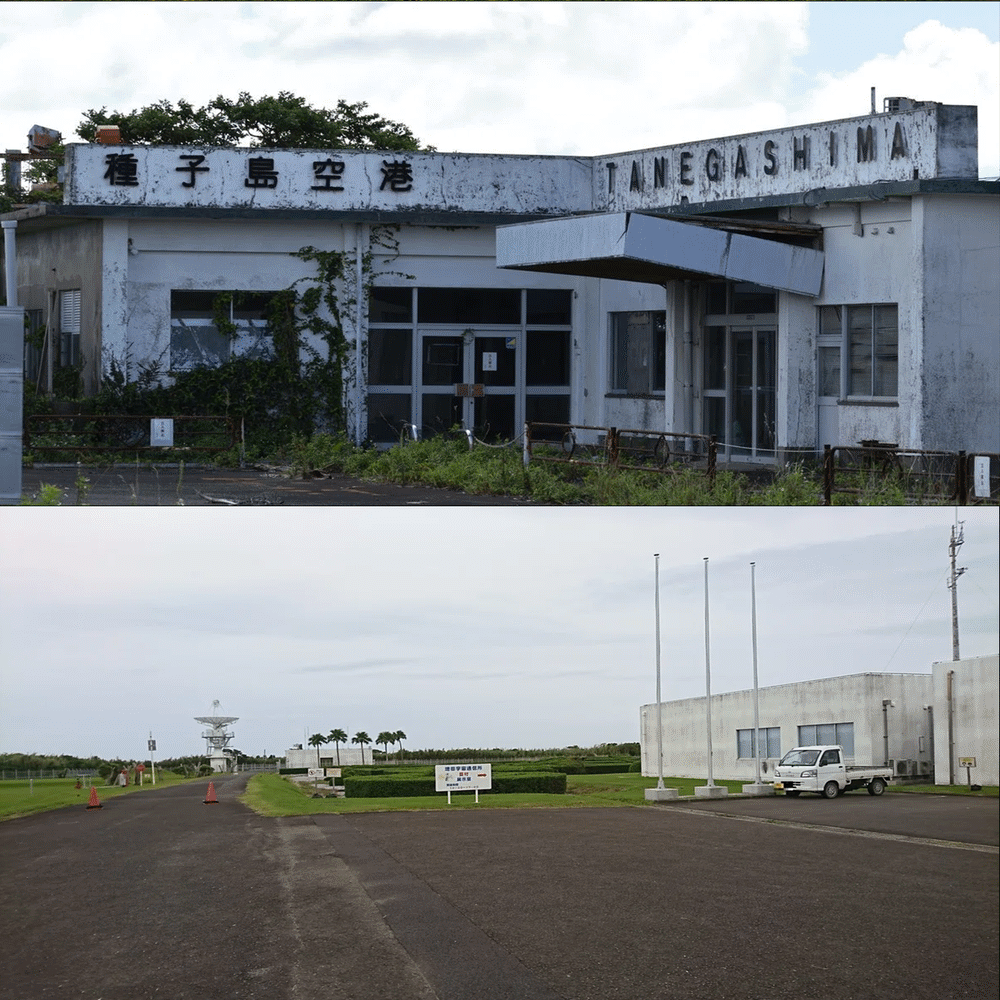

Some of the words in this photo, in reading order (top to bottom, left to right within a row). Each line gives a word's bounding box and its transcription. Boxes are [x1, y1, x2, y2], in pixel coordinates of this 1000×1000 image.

[103, 153, 414, 192] 種子島空港
[605, 121, 910, 194] TANEGASHIMA
